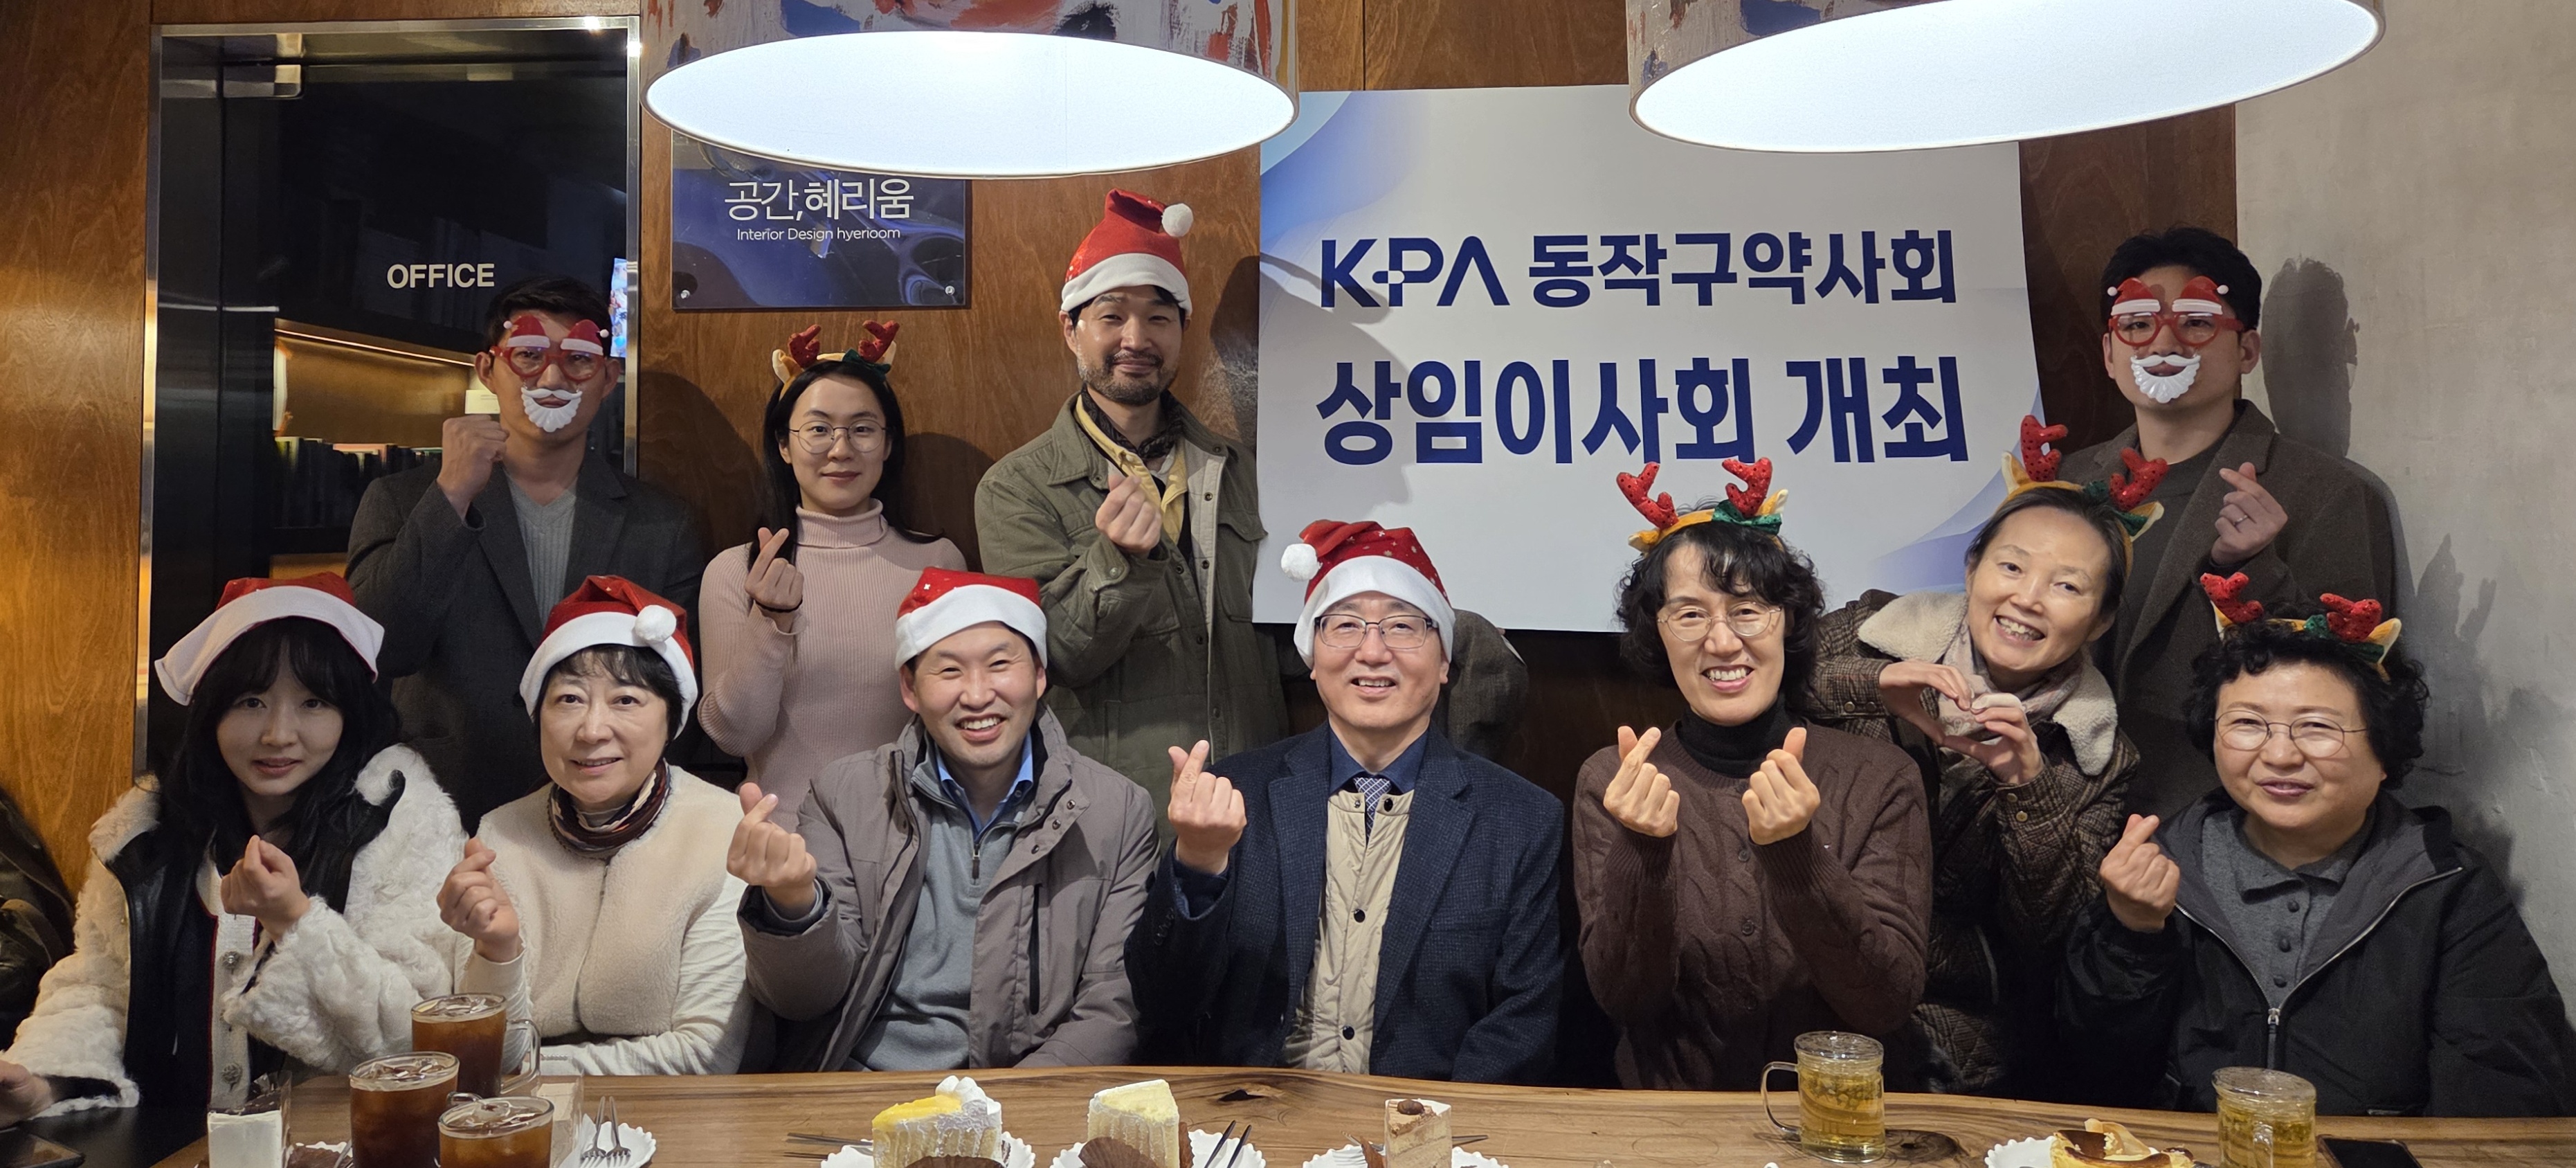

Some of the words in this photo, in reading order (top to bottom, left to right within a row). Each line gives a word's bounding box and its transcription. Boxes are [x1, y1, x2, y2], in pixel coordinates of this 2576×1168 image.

[725, 179, 914, 221] 공간,혜리움
[737, 227, 785, 241] Interior
[788, 228, 833, 242] Design
[837, 227, 900, 241] hyerioom
[387, 263, 495, 289] OFFICE
[1529, 230, 1957, 308] 동작구약사회
[1316, 357, 1756, 466] 상임이사회
[1786, 355, 1969, 463] 개최
